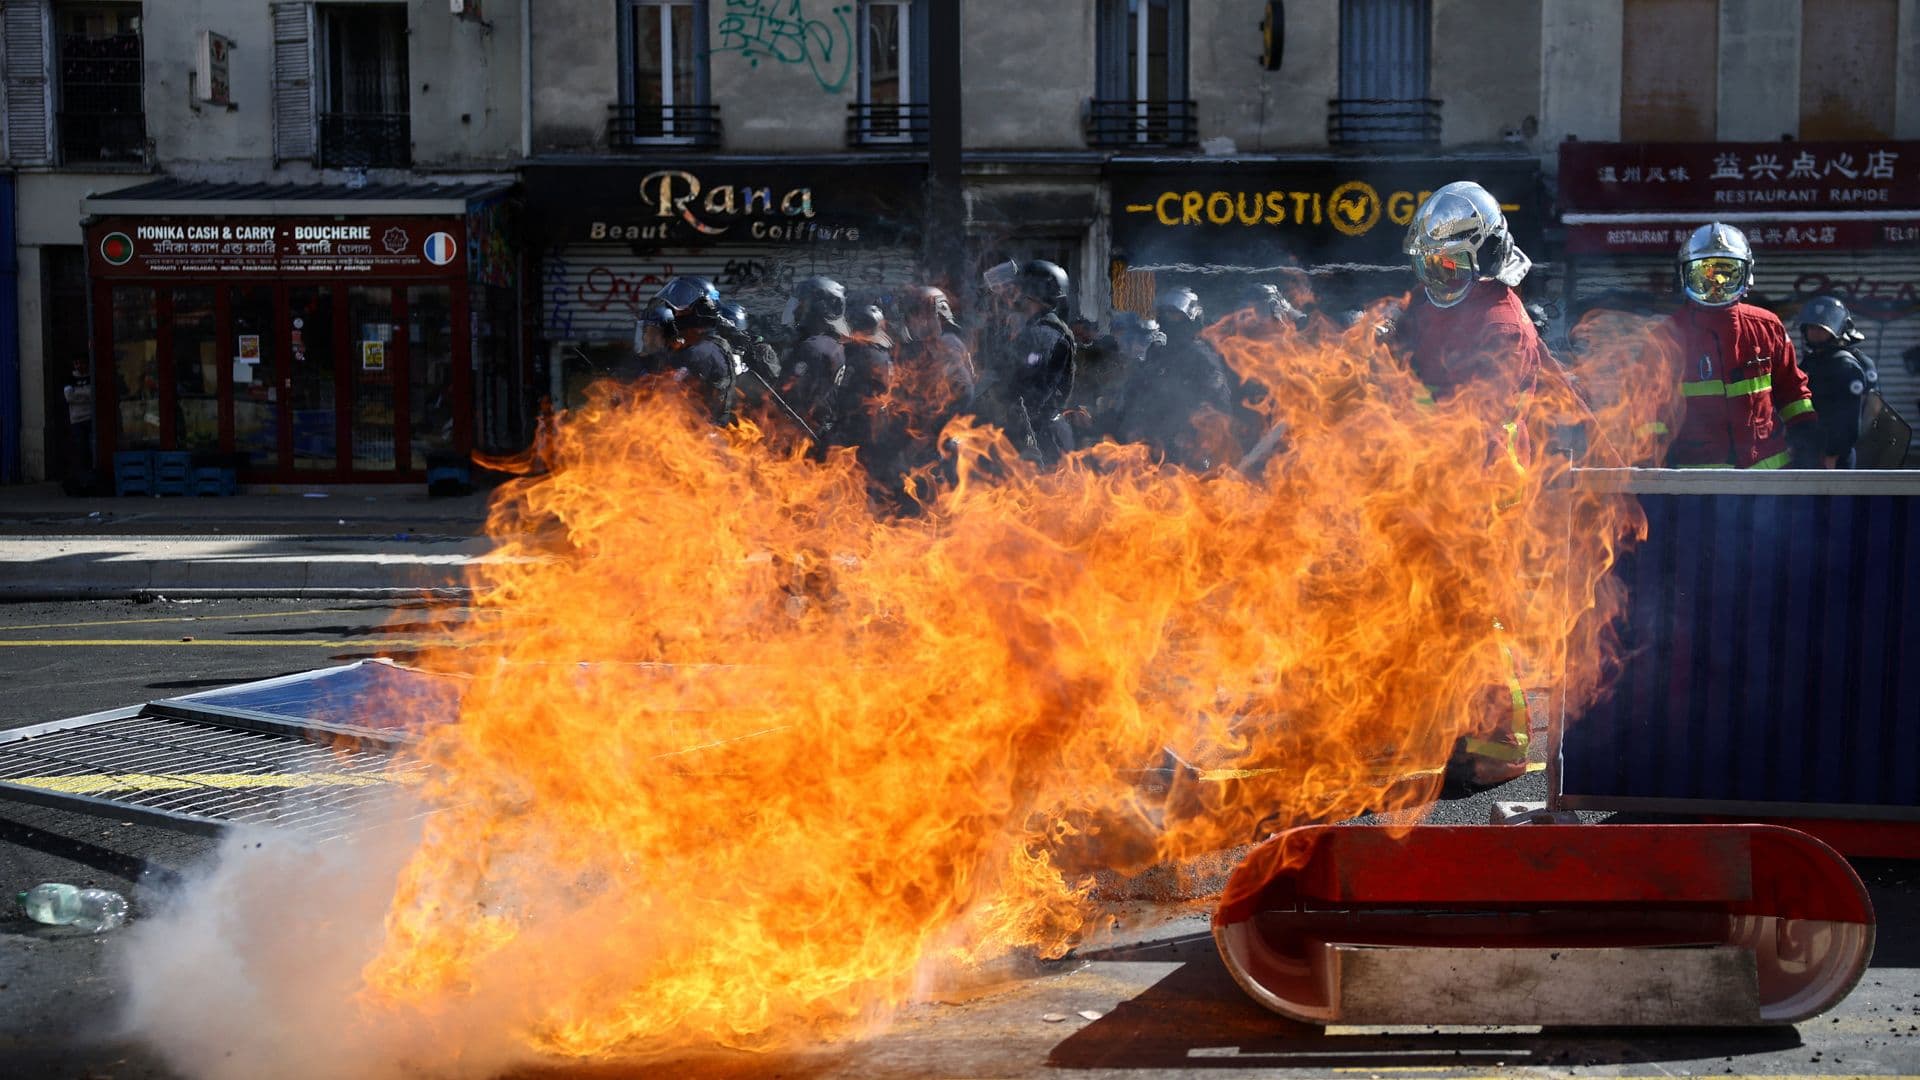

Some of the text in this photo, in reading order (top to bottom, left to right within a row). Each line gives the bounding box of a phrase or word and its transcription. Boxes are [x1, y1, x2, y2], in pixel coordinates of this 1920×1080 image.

[1597, 164, 1691, 184] 温州风味
[1709, 149, 1899, 181] 益兴点心店
[639, 169, 817, 235] Rana
[1714, 188, 1889, 203] RESTAURANT RAPIDE
[1155, 190, 1322, 226] CROUSTI
[137, 225, 185, 240] MONIKA
[187, 225, 219, 240] CASH
[222, 225, 233, 240] &
[235, 225, 276, 240] CARRY
[294, 225, 372, 240] BOUCHERIE
[751, 220, 860, 241] Coiffure
[1606, 229, 1669, 244] RESTAURANT
